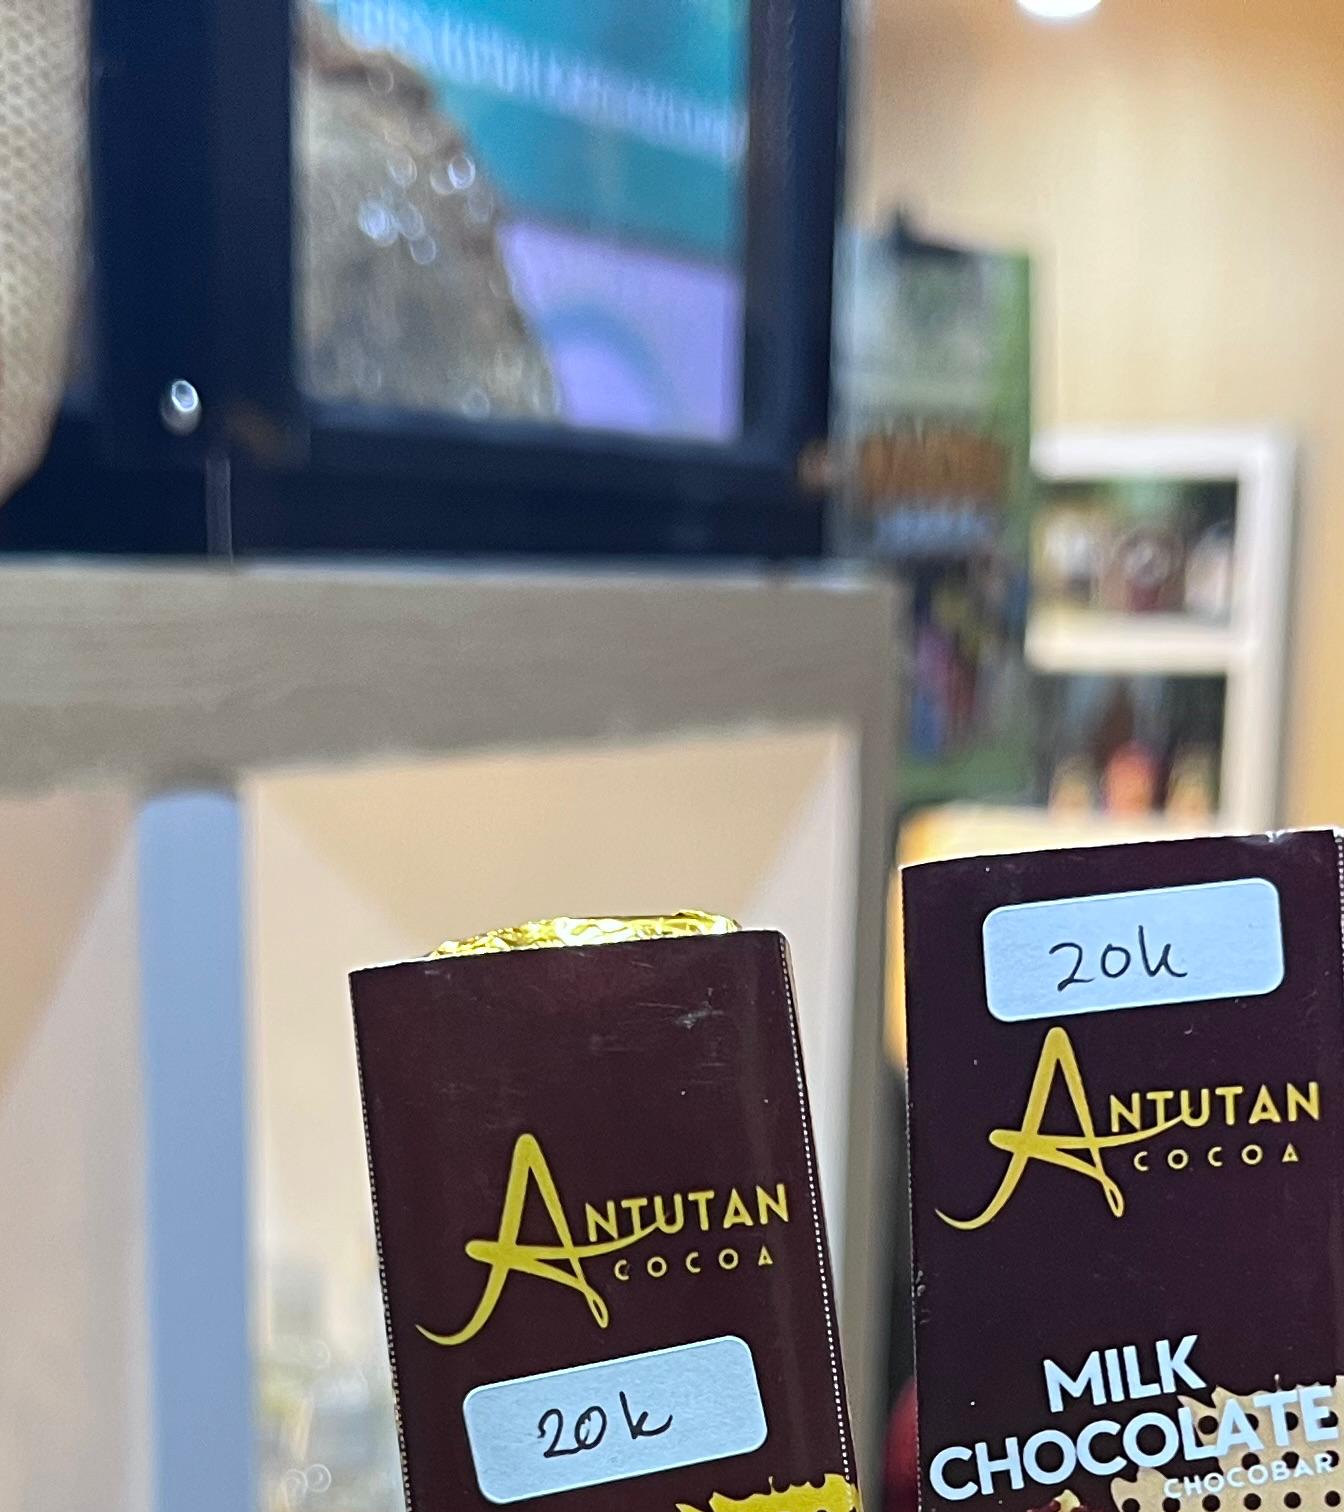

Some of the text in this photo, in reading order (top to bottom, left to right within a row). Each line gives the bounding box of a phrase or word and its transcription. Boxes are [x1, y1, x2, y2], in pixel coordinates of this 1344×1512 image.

[1048, 925, 1189, 992] 20k
[934, 1026, 1322, 1231] ANTUTAN
[1133, 1142, 1300, 1172] COCOA
[415, 1132, 790, 1346] ANTUTAN
[613, 1244, 774, 1282] COCOA
[1043, 1333, 1207, 1414] MILK
[537, 1390, 674, 1459] 20k
[929, 1384, 1340, 1503] CHOCOLATE
[1163, 1452, 1335, 1501] CHOCOBAR
